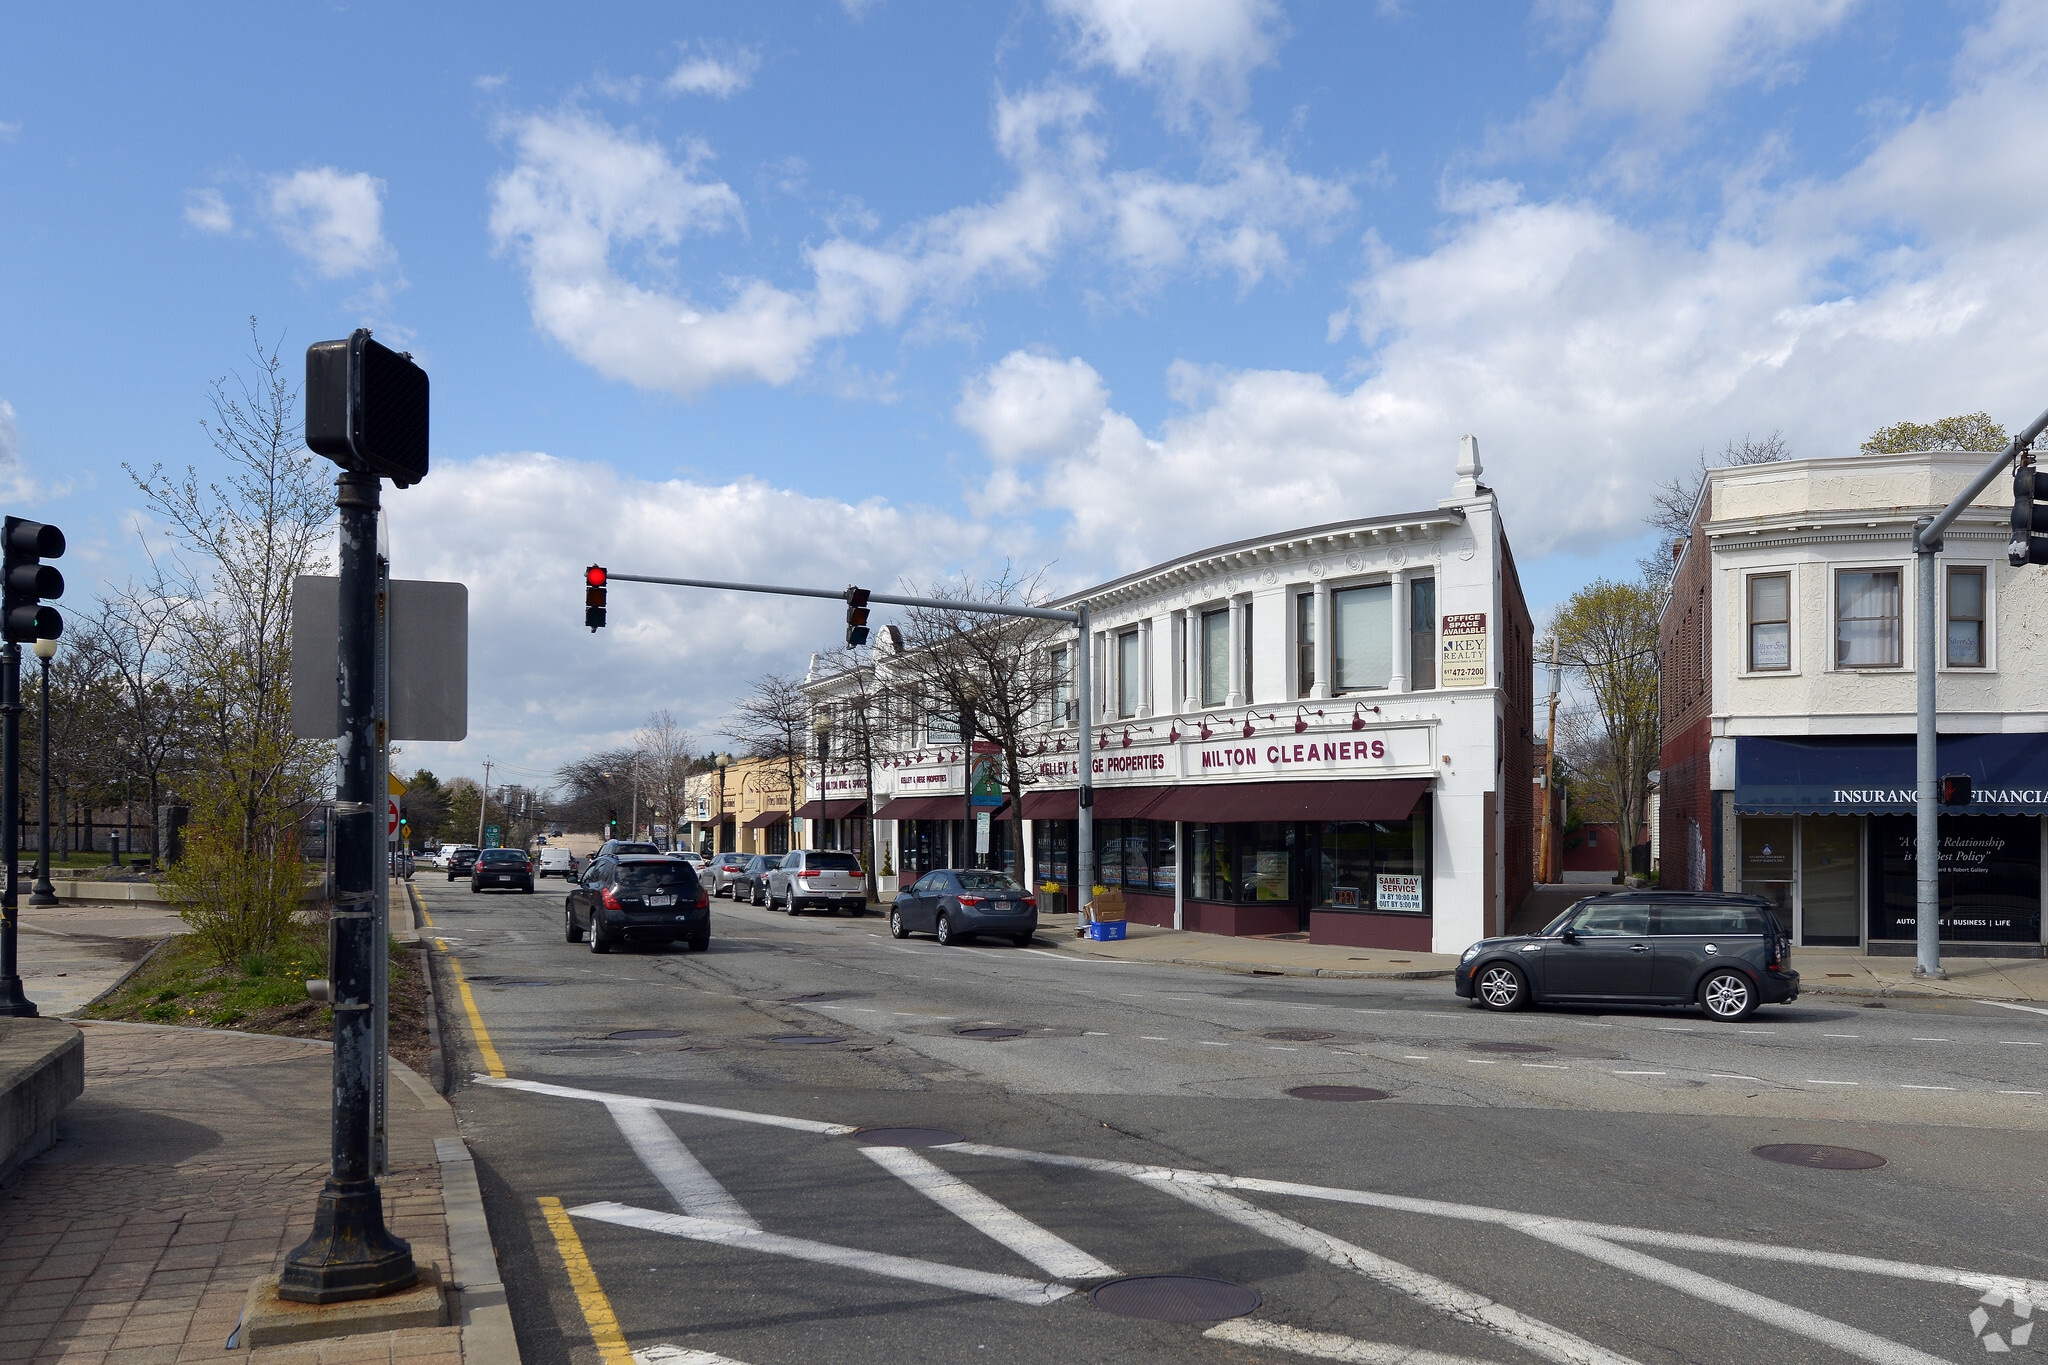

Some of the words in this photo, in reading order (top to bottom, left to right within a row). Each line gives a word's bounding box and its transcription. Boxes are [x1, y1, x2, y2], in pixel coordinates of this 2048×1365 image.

[1448, 614, 1480, 622] OFFICE
[1444, 627, 1485, 635] AVAILABLE
[1455, 639, 1484, 650] KEY
[1444, 651, 1484, 659] REALTY
[1202, 748, 1256, 768] MILTON
[1267, 740, 1385, 764] CLEANERS
[1040, 761, 1068, 776] KELLEY
[1072, 762, 1077, 774] &
[1108, 754, 1164, 772] PROPERTIES
[1834, 790, 1918, 802] INSURANC
[1944, 837, 2005, 850] Relationship
[1904, 851, 1912, 860] is
[1335, 890, 1356, 904] OPEN
